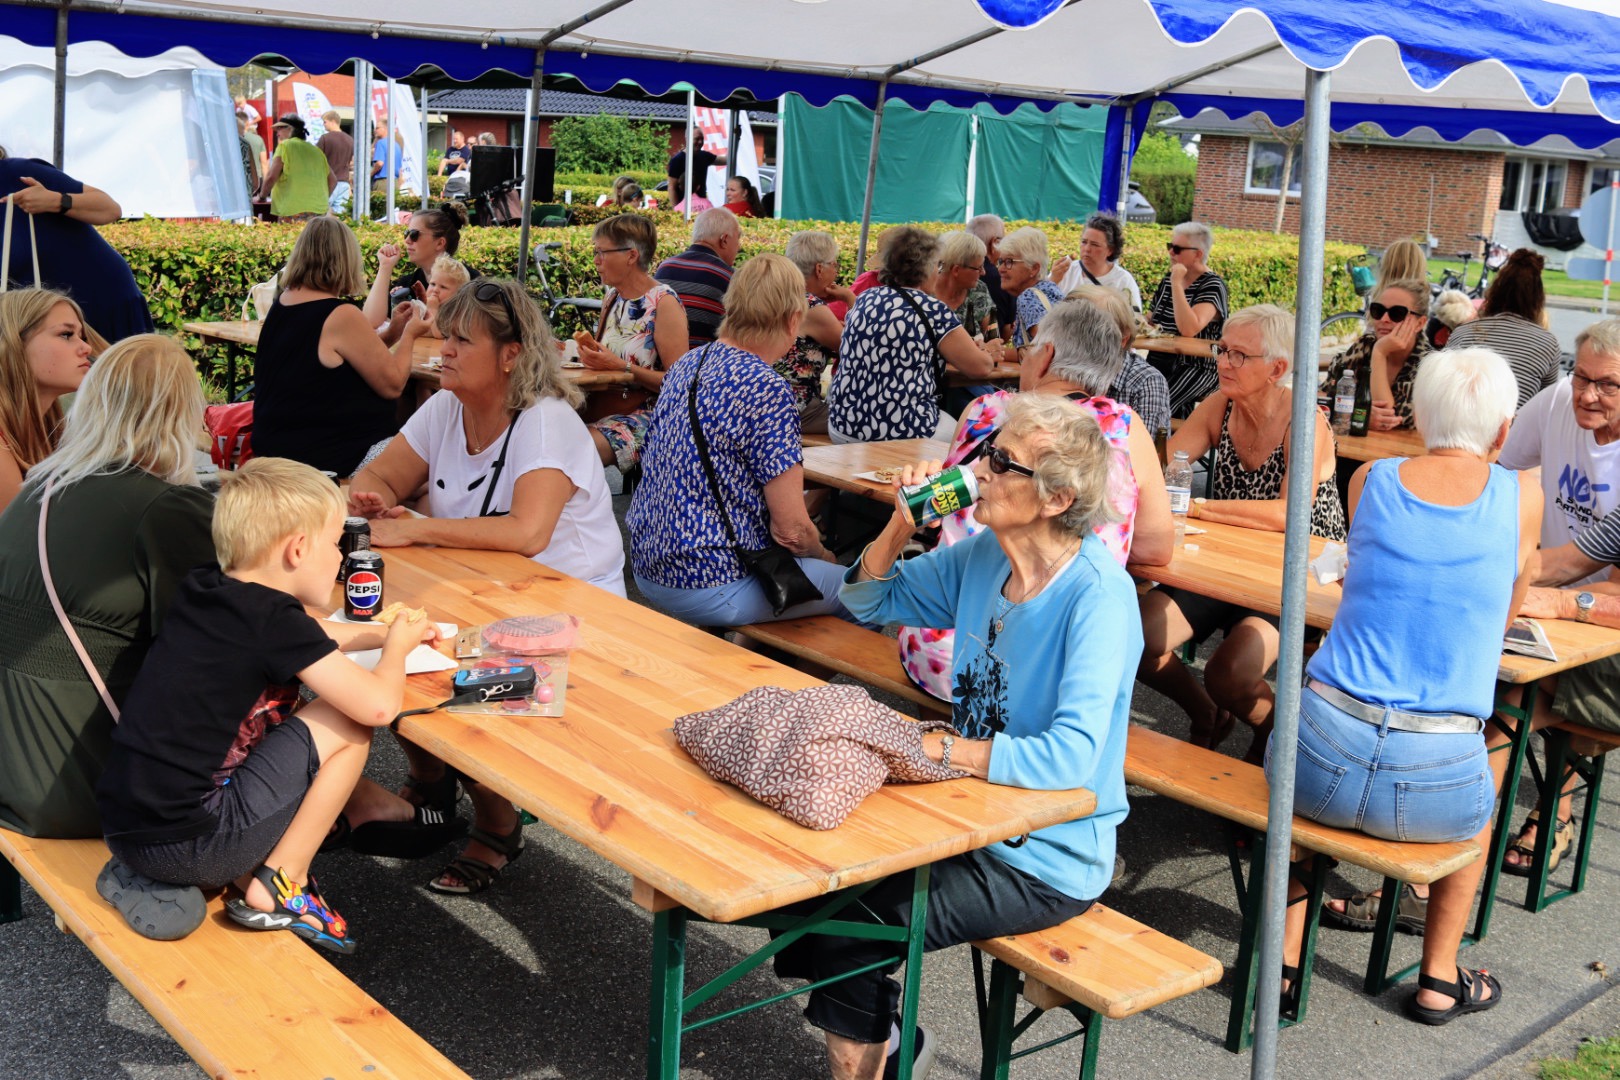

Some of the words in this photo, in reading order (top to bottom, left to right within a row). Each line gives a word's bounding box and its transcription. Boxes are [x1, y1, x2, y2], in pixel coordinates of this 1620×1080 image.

[931, 482, 951, 516] KOND
[943, 483, 961, 512] FAXE
[348, 584, 380, 594] PEPSI
